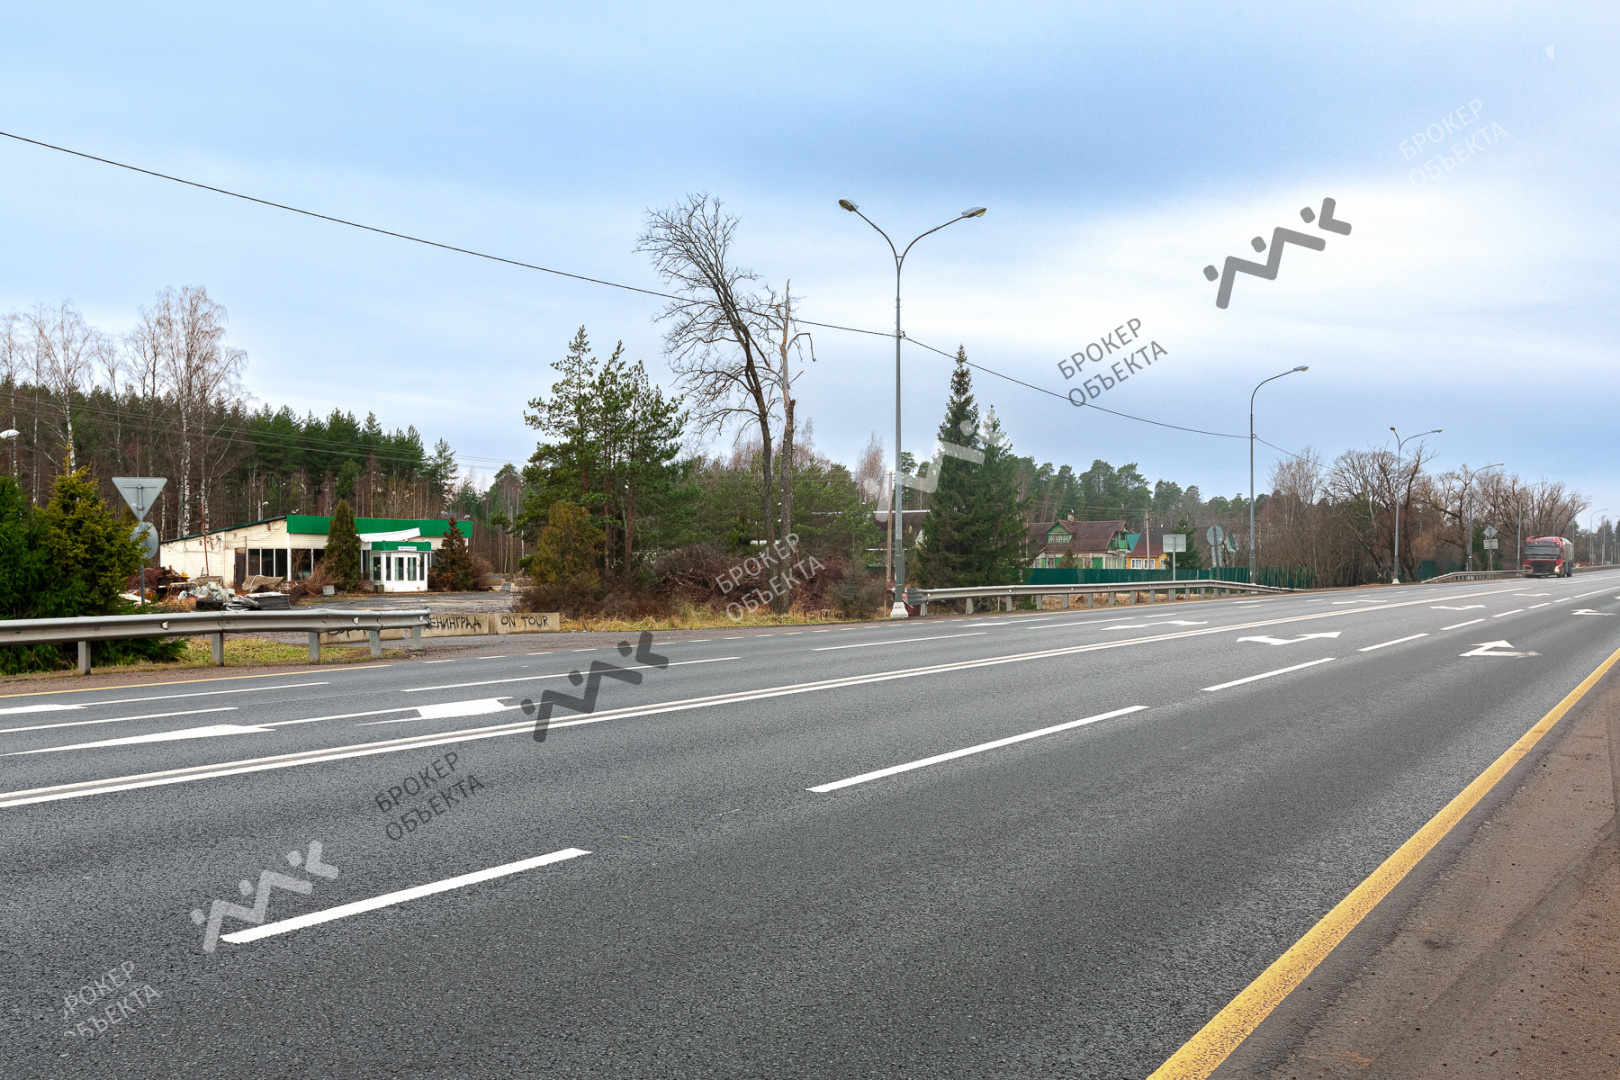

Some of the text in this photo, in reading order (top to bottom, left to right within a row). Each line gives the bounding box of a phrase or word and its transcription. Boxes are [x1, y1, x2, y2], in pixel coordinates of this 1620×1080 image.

[427, 615, 551, 632] ЕНИНГРАД ON TOUR
